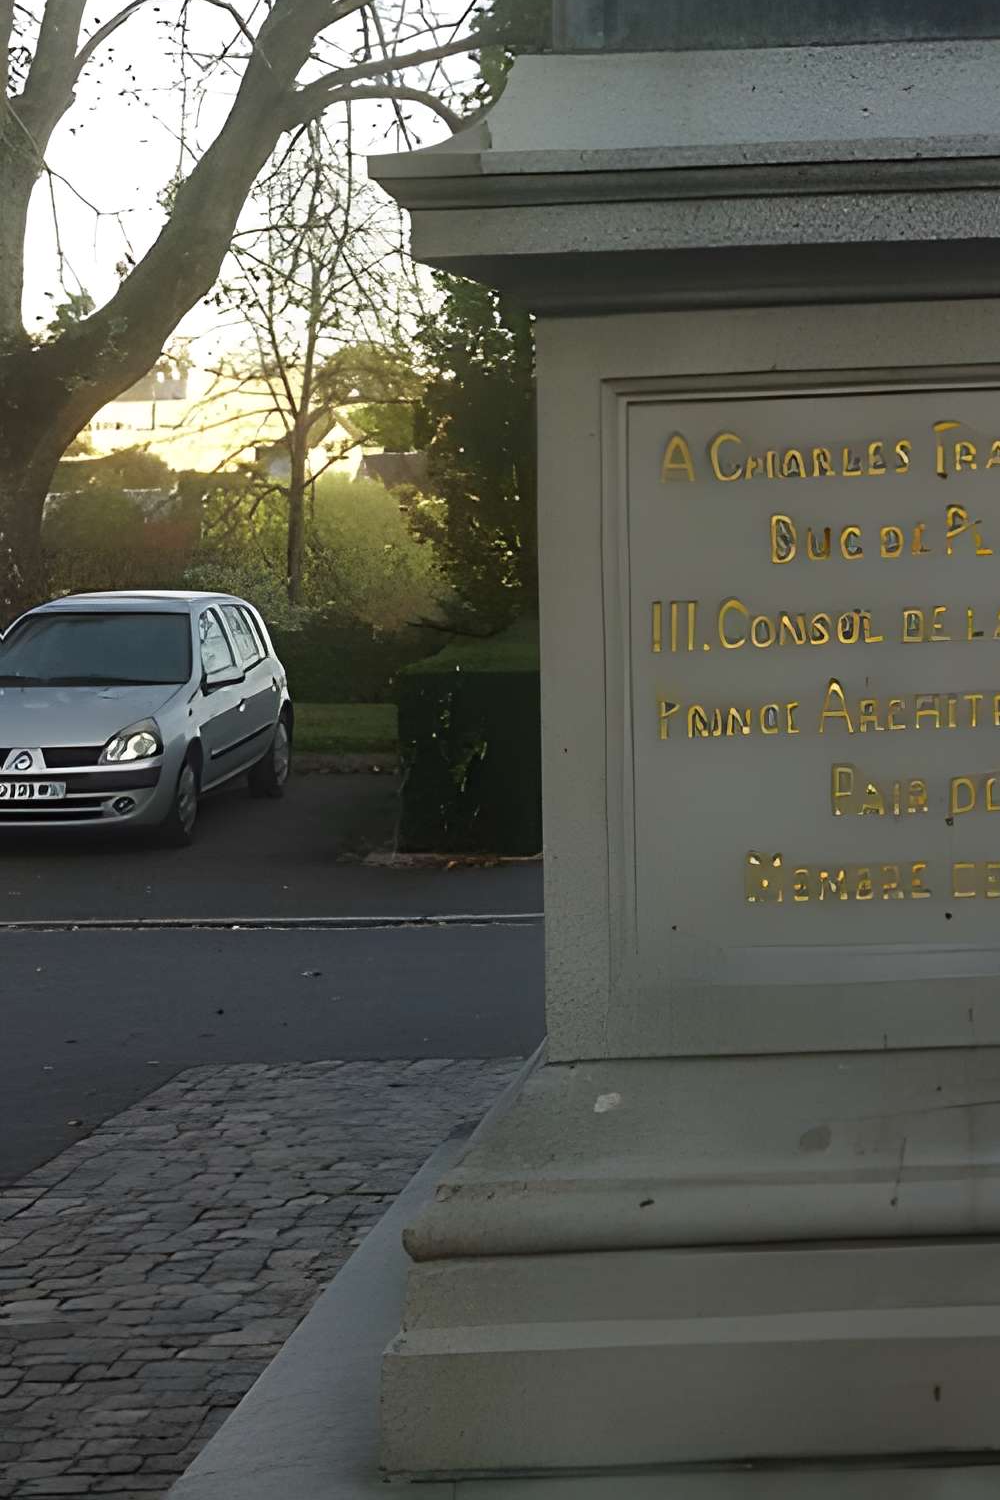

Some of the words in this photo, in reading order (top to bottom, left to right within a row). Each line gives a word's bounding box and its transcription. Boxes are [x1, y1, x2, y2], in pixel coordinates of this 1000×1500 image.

[660, 430, 697, 484] A
[708, 430, 912, 483] CHARLES
[902, 604, 951, 643] DE
